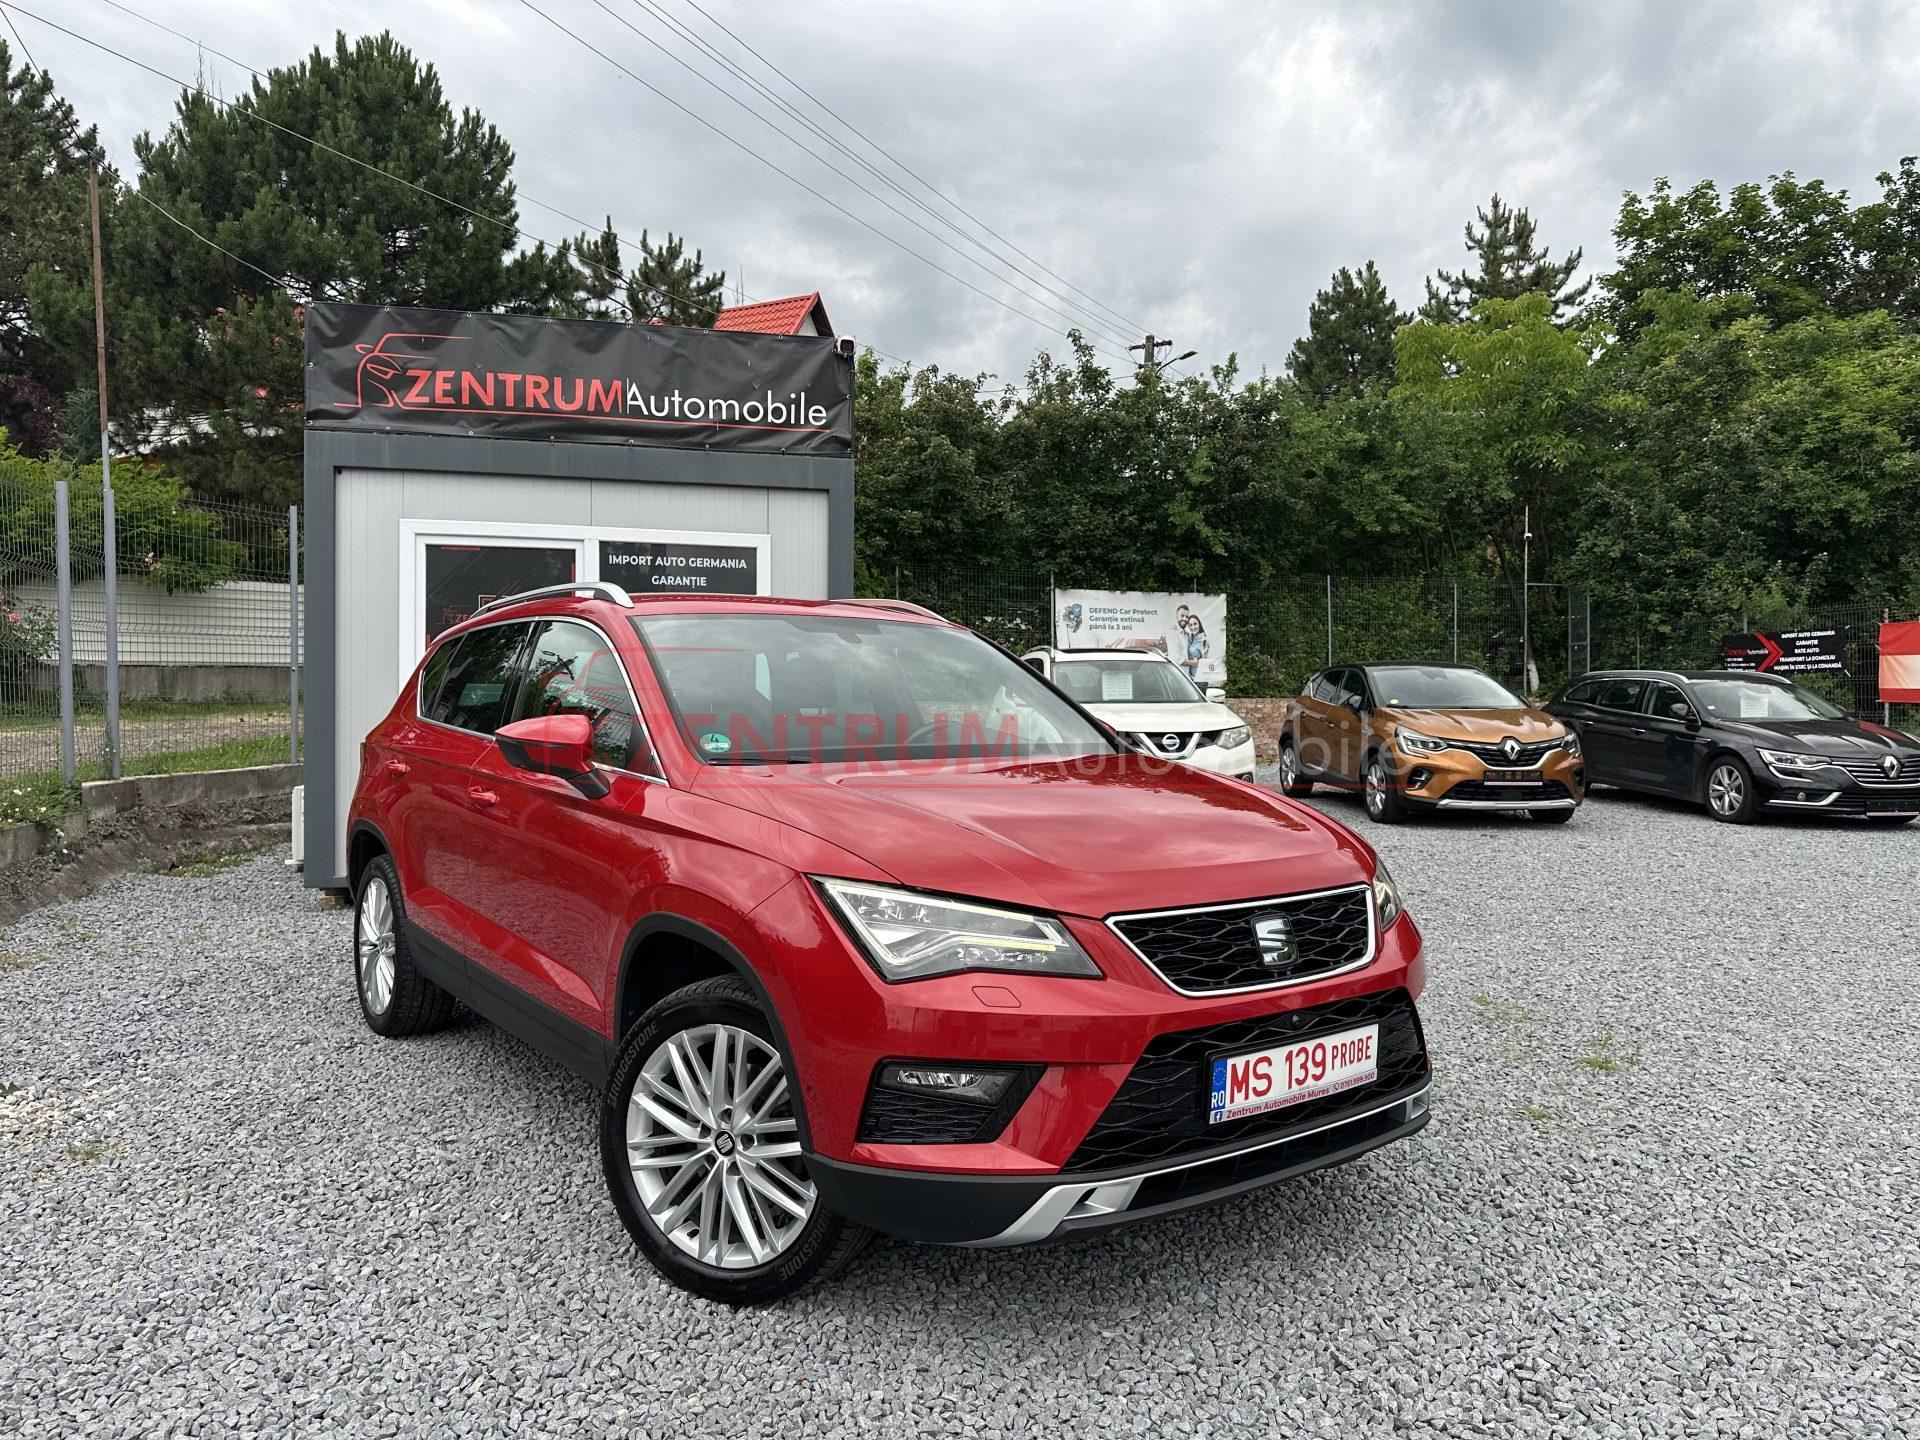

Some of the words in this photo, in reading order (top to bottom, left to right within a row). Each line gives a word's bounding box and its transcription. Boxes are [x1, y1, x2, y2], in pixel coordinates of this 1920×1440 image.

[402, 368, 623, 415] ZENTRUM
[627, 379, 828, 427] Automobile
[608, 554, 653, 566] IMPORT
[655, 556, 687, 567] AUTO
[688, 557, 747, 569] GERMANIA
[651, 575, 707, 588] GARANȚIE
[1132, 608, 1158, 616] Protect
[1229, 1055, 1273, 1104] MS
[1284, 1042, 1327, 1090] 139
[1331, 1035, 1373, 1071] PROBE
[1211, 1090, 1226, 1109] RO
[1226, 1105, 1262, 1119] Zentrum
[1263, 1093, 1307, 1111] Automobile
